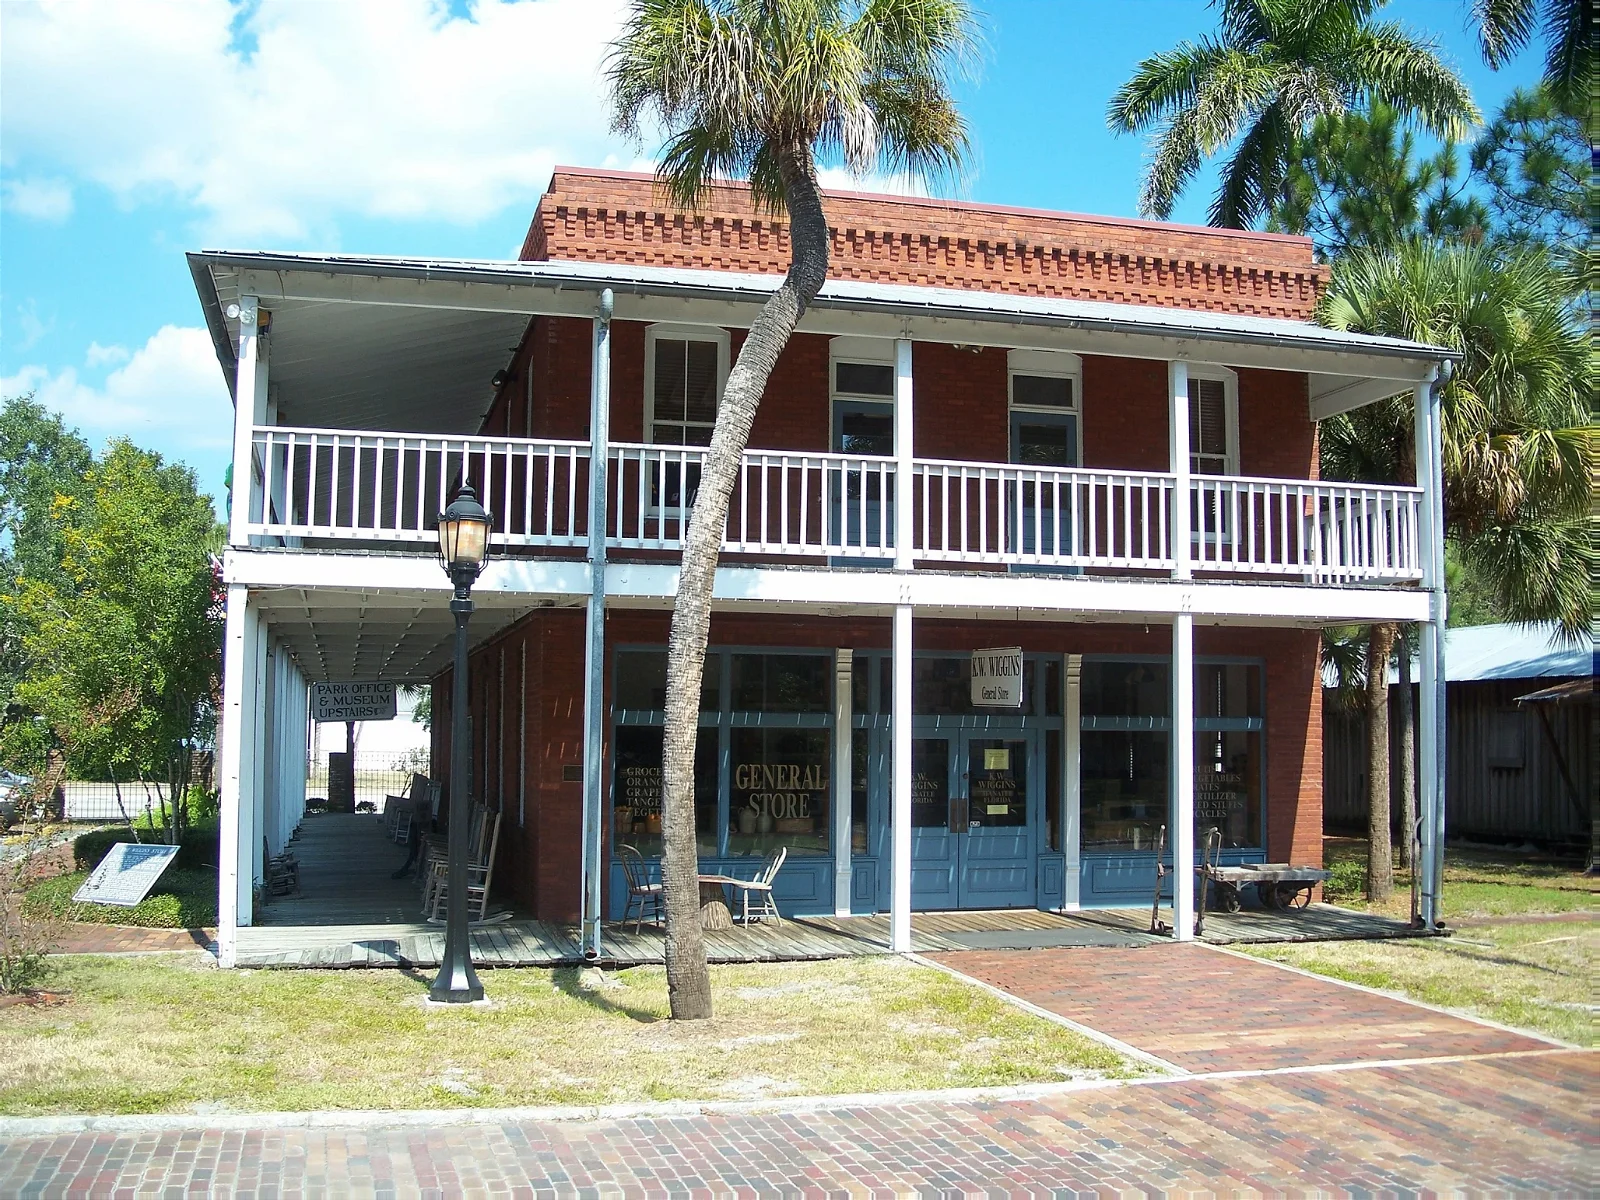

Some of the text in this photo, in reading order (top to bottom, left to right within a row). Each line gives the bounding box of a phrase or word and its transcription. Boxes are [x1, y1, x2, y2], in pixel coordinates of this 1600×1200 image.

[989, 655, 1020, 676] WIGGINS
[317, 683, 391, 694] PARK OFFICE
[981, 686, 1009, 700] General Store
[319, 695, 390, 706] & MUSEUM
[319, 706, 374, 718] UPSTAIRS
[626, 767, 663, 776] GROCE
[735, 763, 827, 790] GENERAL
[978, 780, 1016, 789] WIGGINS
[626, 787, 662, 796] GRAPE
[626, 797, 661, 807] TANGE
[749, 792, 811, 819] STORE
[1194, 810, 1227, 818] CYCLES
